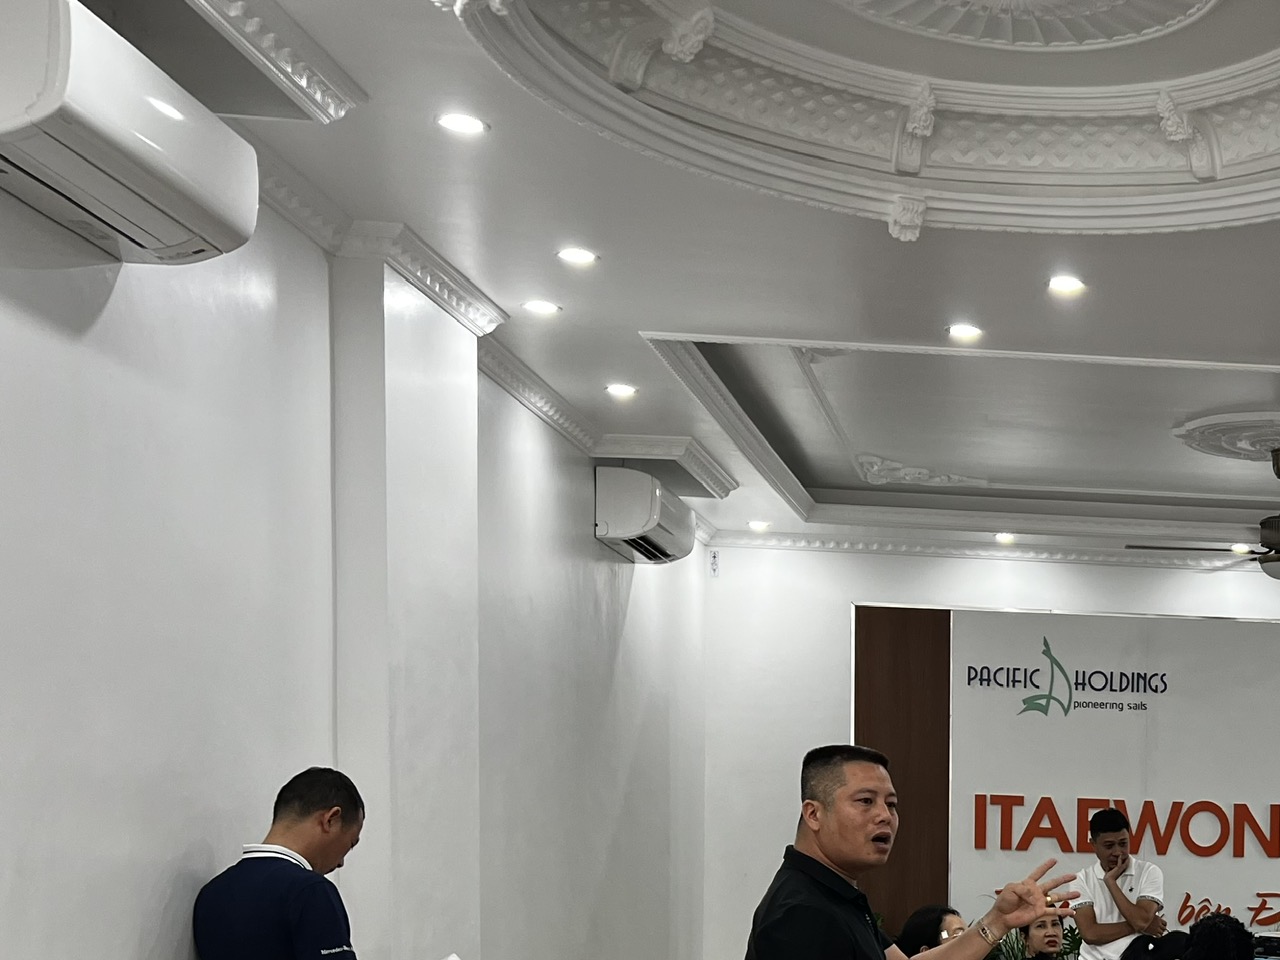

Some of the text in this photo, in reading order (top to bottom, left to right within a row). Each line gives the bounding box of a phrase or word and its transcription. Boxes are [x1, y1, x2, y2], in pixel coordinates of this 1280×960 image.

[967, 665, 1168, 693] PACIFIC HOLDINGS
[1073, 700, 1148, 711] pioneering sails
[973, 793, 1280, 858] ITAEWON
